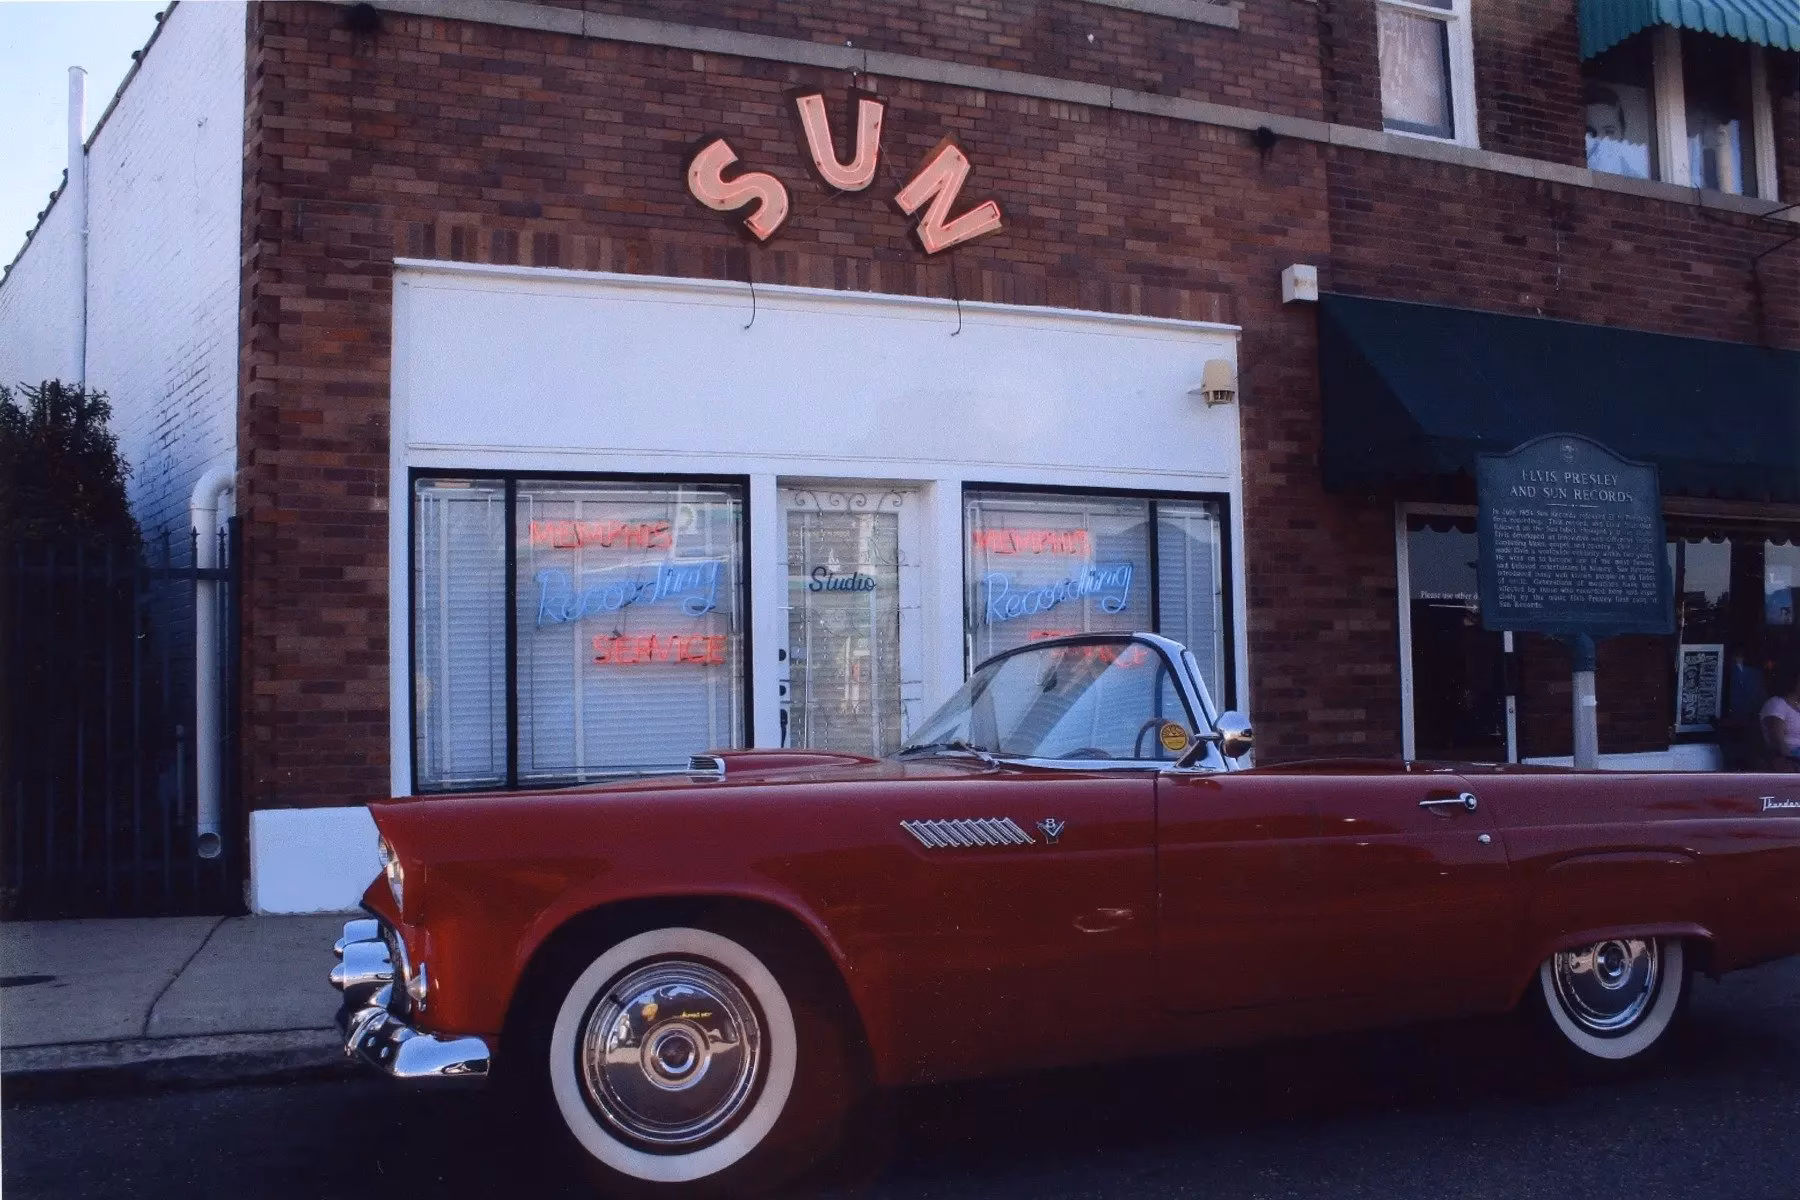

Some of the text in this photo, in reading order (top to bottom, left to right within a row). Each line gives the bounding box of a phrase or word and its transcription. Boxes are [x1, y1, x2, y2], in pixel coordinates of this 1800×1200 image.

[688, 94, 1003, 255] SUN
[1510, 486, 1633, 502] AND SUN RECORDS
[1521, 469, 1618, 486] ELVIS PRESLEY
[535, 560, 722, 628] Recording
[809, 566, 876, 592] Studio
[985, 561, 1134, 625] Recording
[593, 633, 728, 666] SERVICE
